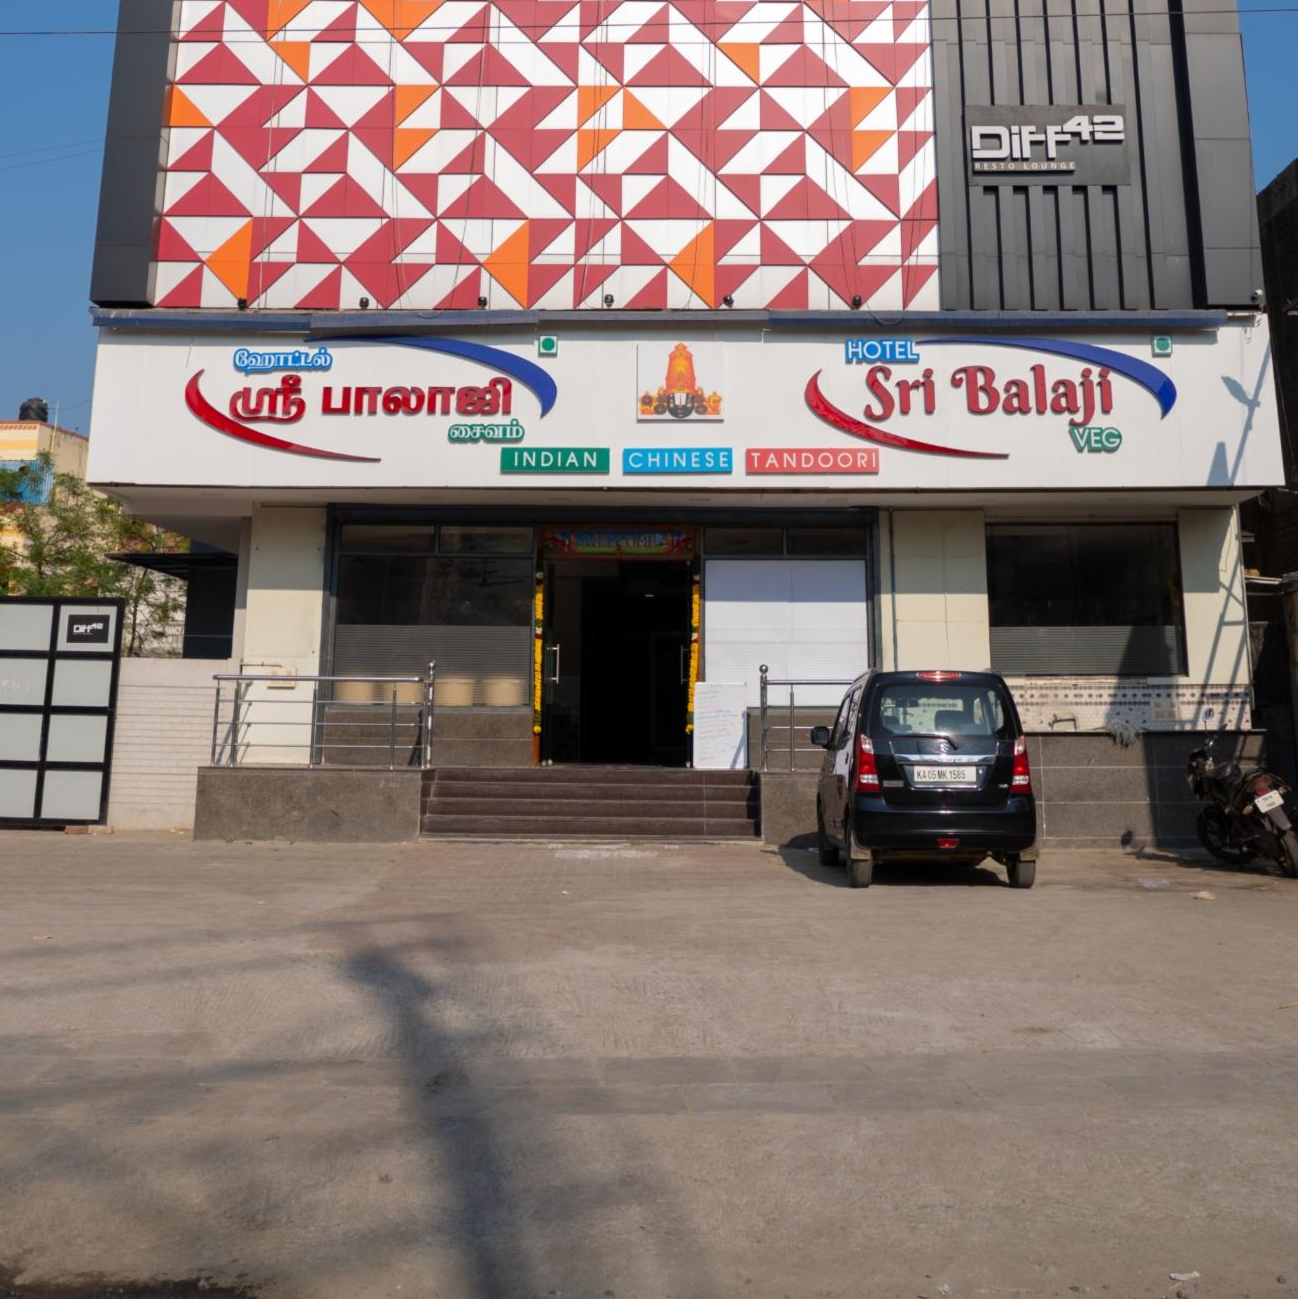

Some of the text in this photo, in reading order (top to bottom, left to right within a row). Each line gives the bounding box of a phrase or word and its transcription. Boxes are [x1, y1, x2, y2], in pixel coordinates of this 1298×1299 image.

[974, 162, 1076, 170] RESTO LOUNGE
[848, 340, 918, 361] HOTEL
[322, 377, 512, 416] பாலாஜி
[864, 363, 1113, 427] Sri Balaji
[449, 420, 524, 441] சைவம்
[1071, 427, 1122, 450] VEG
[514, 451, 597, 467] INDIAN
[629, 452, 729, 468] CHINESE
[751, 452, 878, 469] TANDOORI
